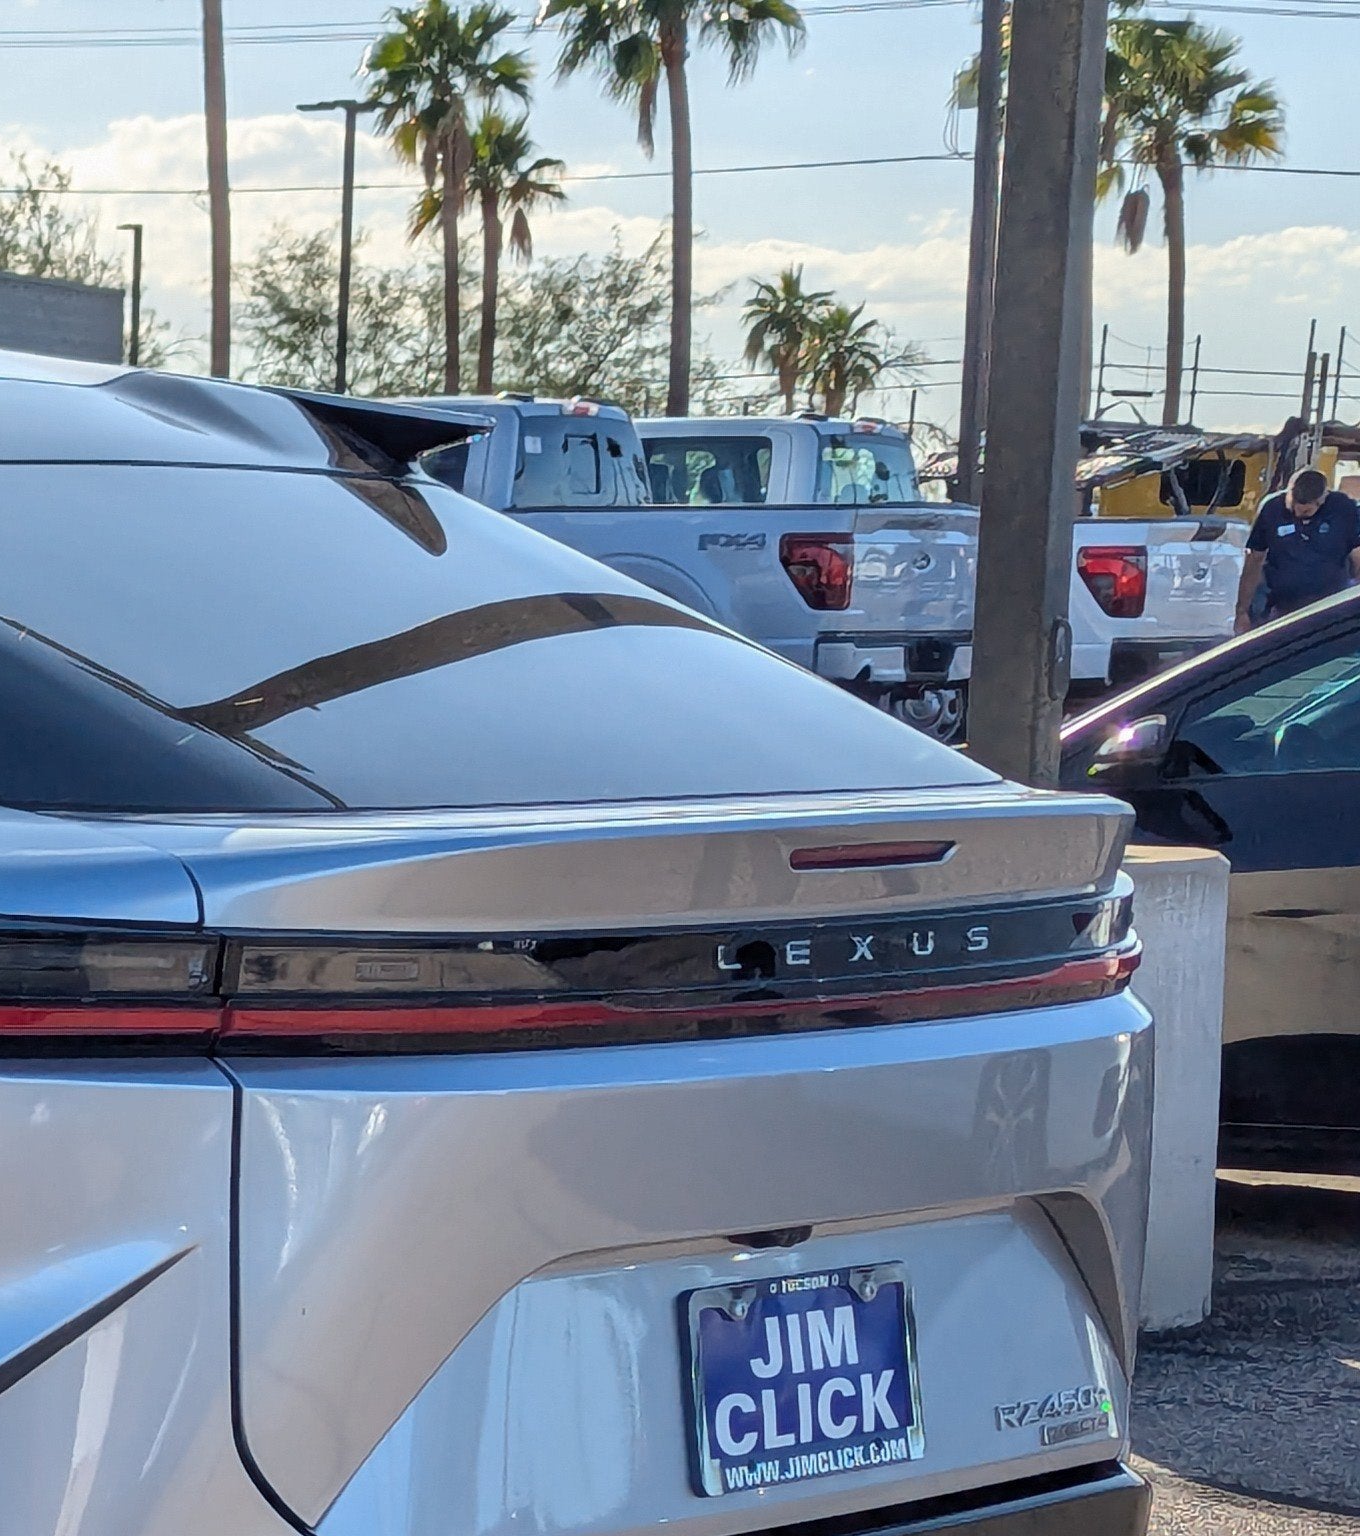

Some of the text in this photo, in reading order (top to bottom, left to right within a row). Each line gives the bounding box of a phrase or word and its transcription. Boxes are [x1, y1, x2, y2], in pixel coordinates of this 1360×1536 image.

[717, 925, 989, 970] LEXUS
[750, 1305, 859, 1379] JIM
[715, 1369, 899, 1456] CLICK
[725, 1437, 908, 1490] WWW.JIMCLICK.COM
